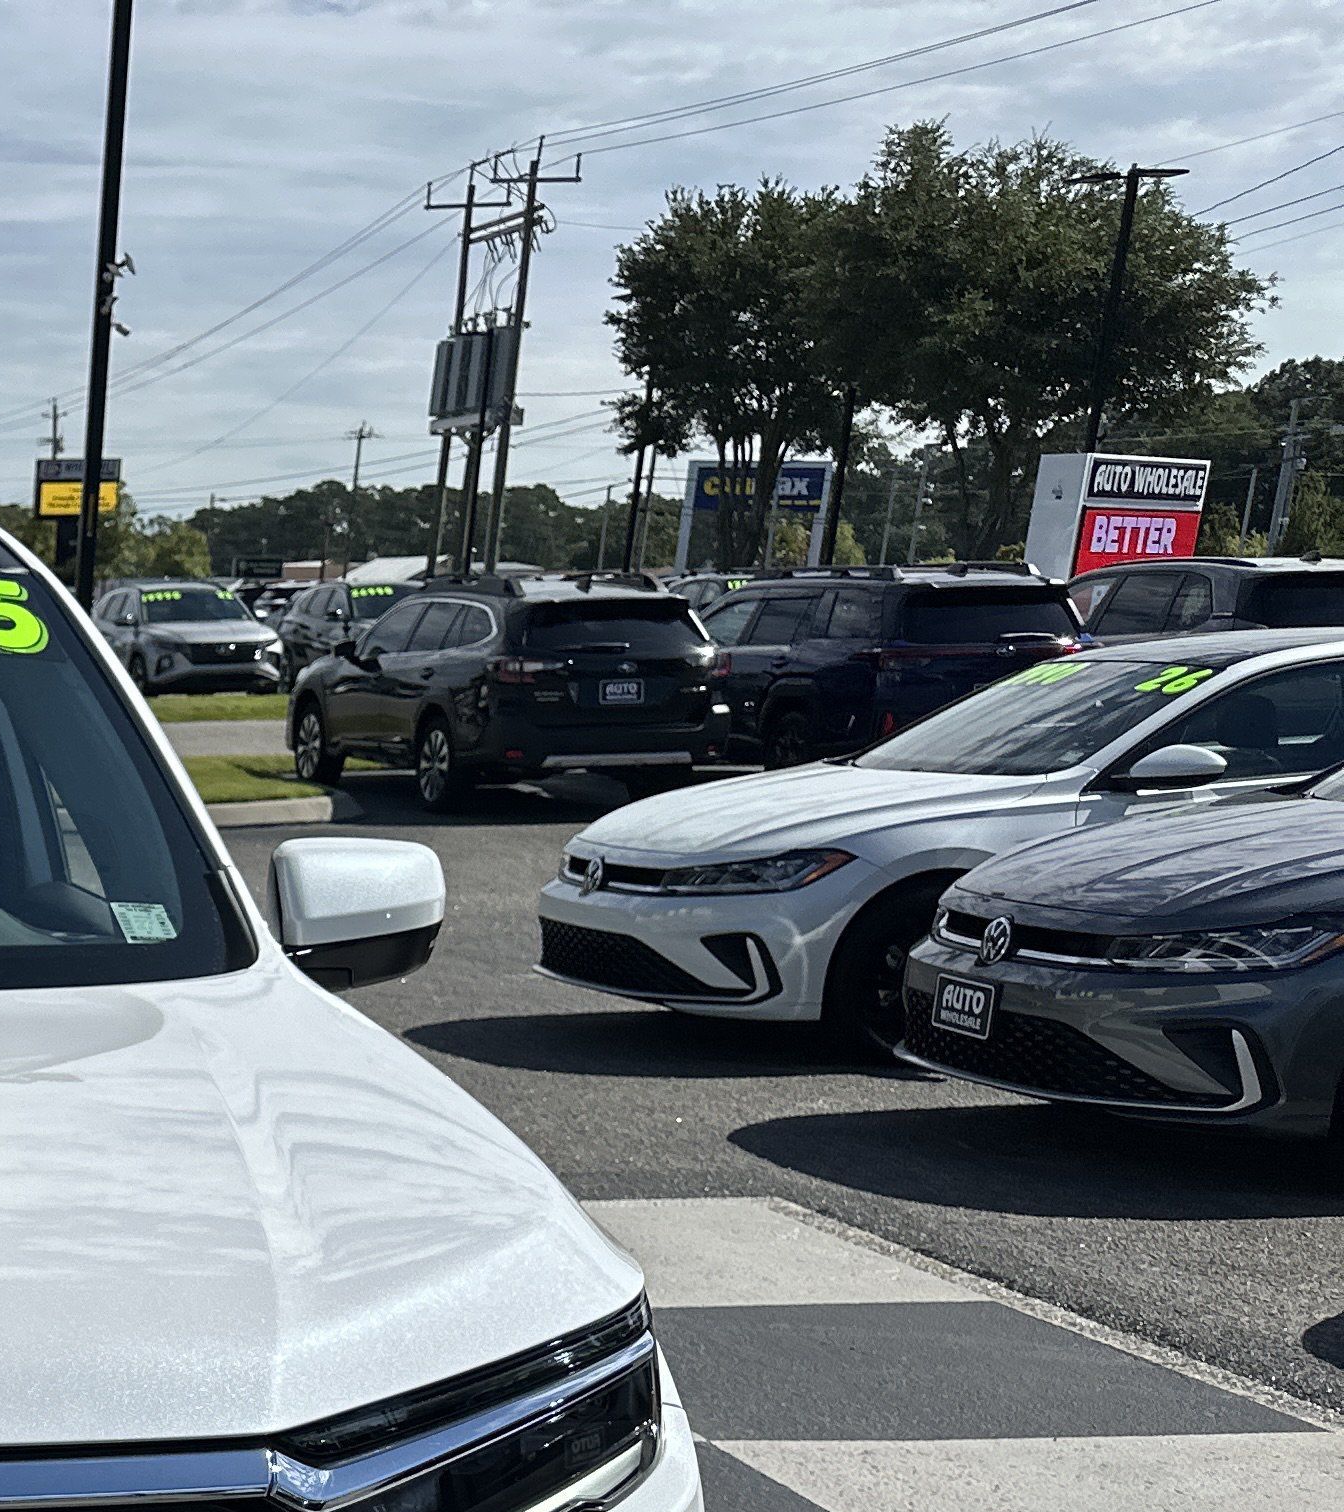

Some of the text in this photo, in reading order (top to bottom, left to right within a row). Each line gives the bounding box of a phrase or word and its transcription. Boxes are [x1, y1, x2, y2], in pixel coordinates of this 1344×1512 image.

[1093, 464, 1205, 497] AUTO WHOLESALE
[1090, 515, 1177, 554] BETTER
[606, 683, 638, 694] AUTO
[1134, 666, 1213, 695] 26
[942, 984, 985, 1015] AUTO
